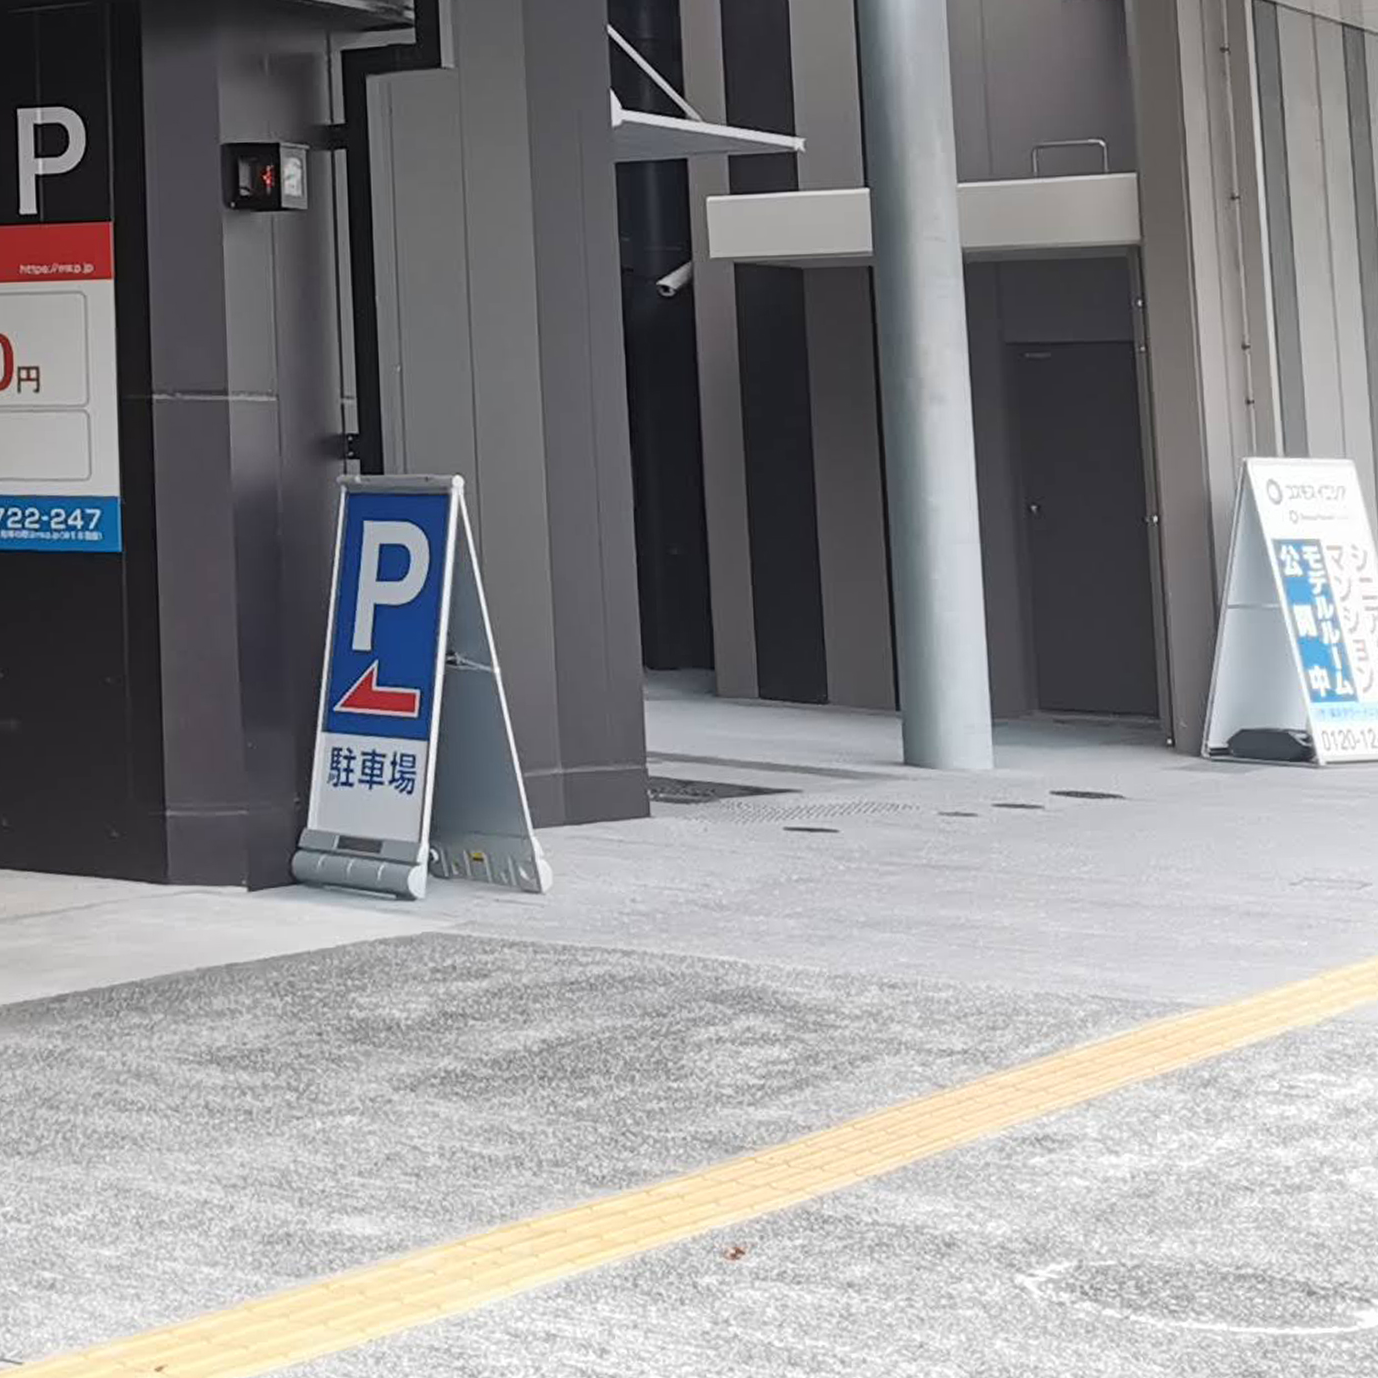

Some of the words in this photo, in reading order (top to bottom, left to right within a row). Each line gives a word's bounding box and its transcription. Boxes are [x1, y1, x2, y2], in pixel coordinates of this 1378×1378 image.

[16, 106, 86, 215] P
[352, 520, 430, 651] P
[328, 746, 417, 796] 駐車場
